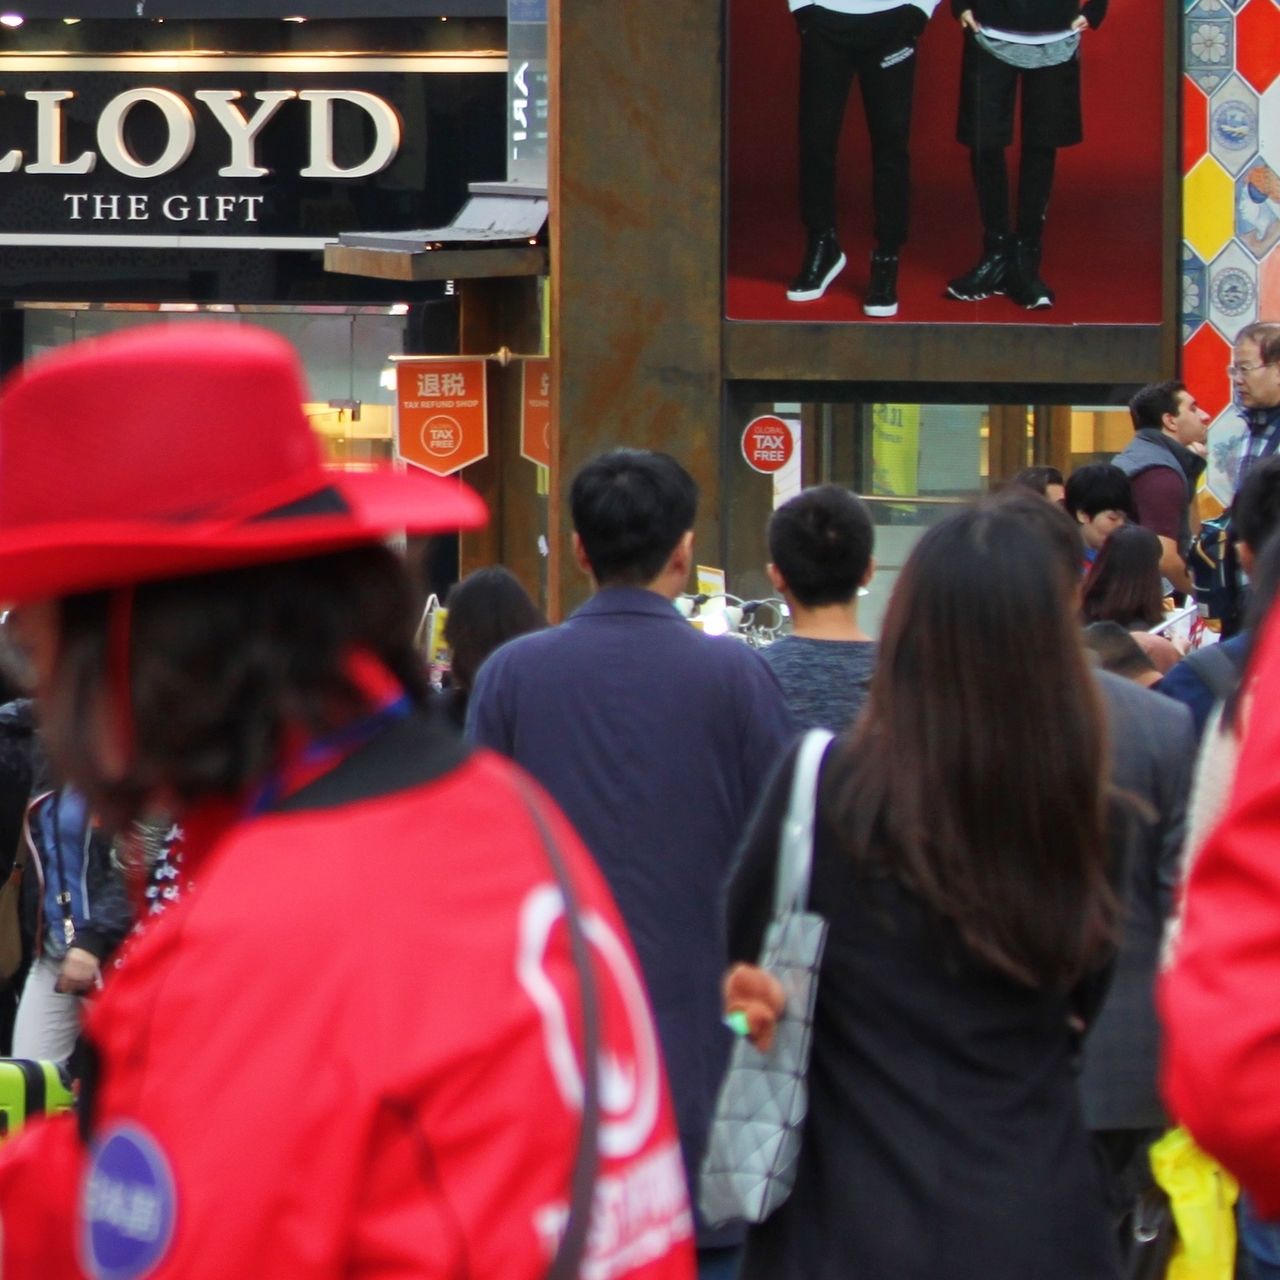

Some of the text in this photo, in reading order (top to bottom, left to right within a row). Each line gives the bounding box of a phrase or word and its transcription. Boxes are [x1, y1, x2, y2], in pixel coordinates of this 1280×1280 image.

[63, 193, 264, 222] THE GIFT
[417, 373, 466, 397] 退税
[430, 429, 454, 440] TAX
[430, 440, 454, 448] FREE
[753, 435, 785, 449] TAX
[754, 450, 785, 461] FREE
